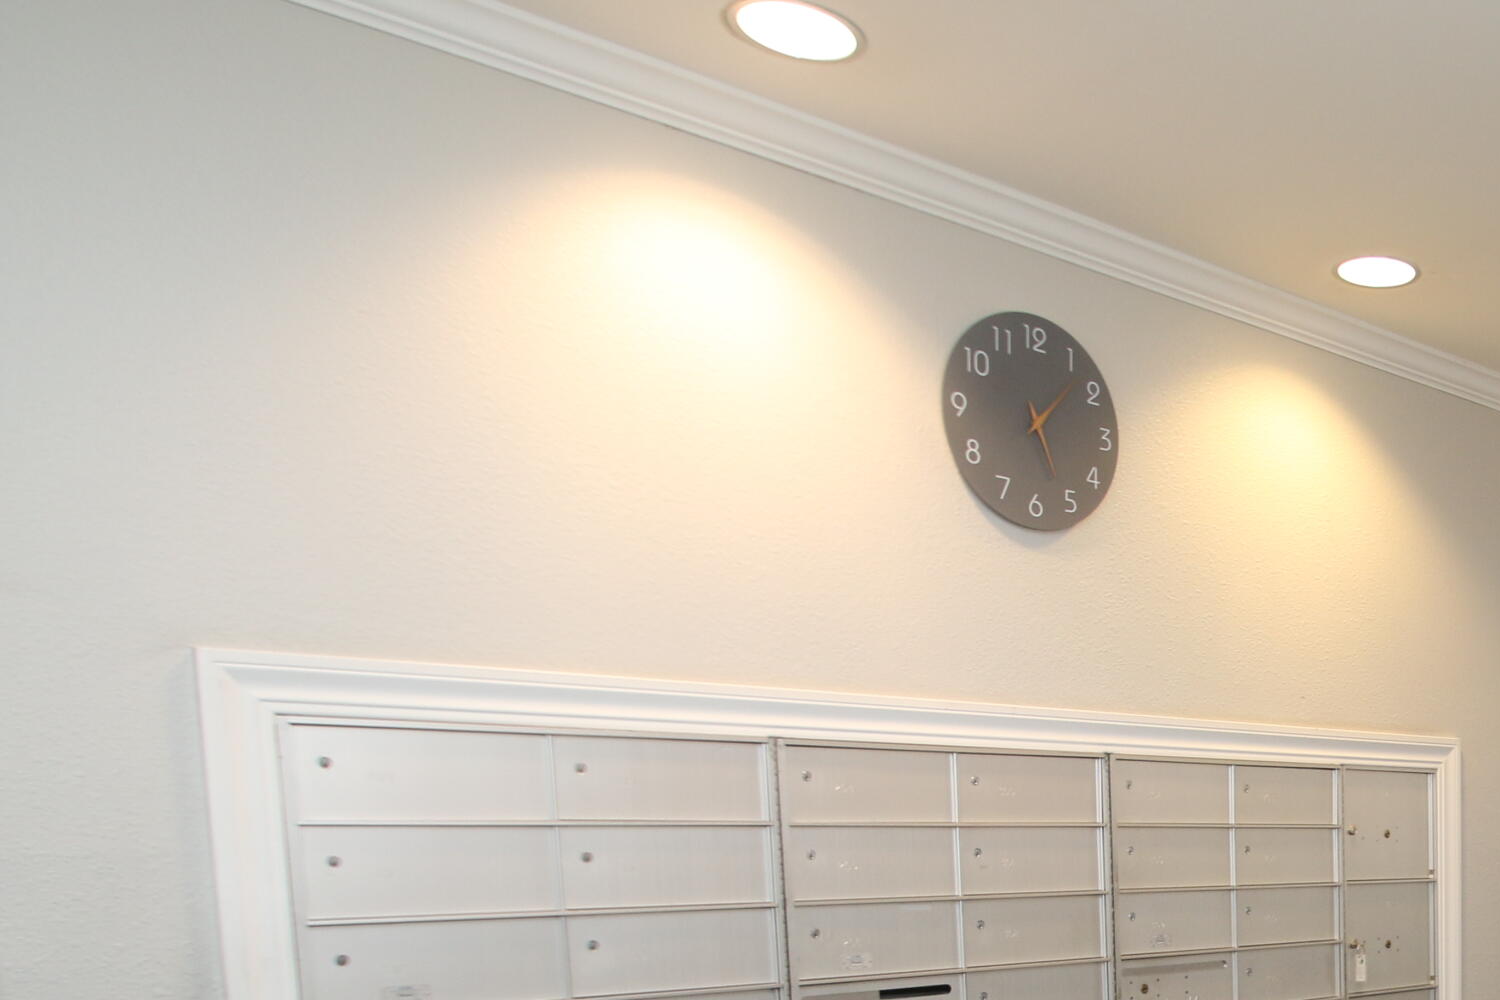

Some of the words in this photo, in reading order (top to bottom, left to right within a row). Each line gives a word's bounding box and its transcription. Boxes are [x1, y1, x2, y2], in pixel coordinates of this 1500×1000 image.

[992, 325, 1012, 355] 11
[1023, 323, 1047, 354] 12
[964, 346, 990, 377] 10
[1066, 347, 1074, 372] 1
[950, 391, 967, 417] 9
[1086, 381, 1101, 407] 2
[965, 438, 981, 465] 8
[1098, 427, 1112, 452] 3
[994, 474, 1011, 500] 7
[1086, 466, 1101, 490] 4
[1028, 493, 1044, 518] 6
[1064, 489, 1078, 514] 5
